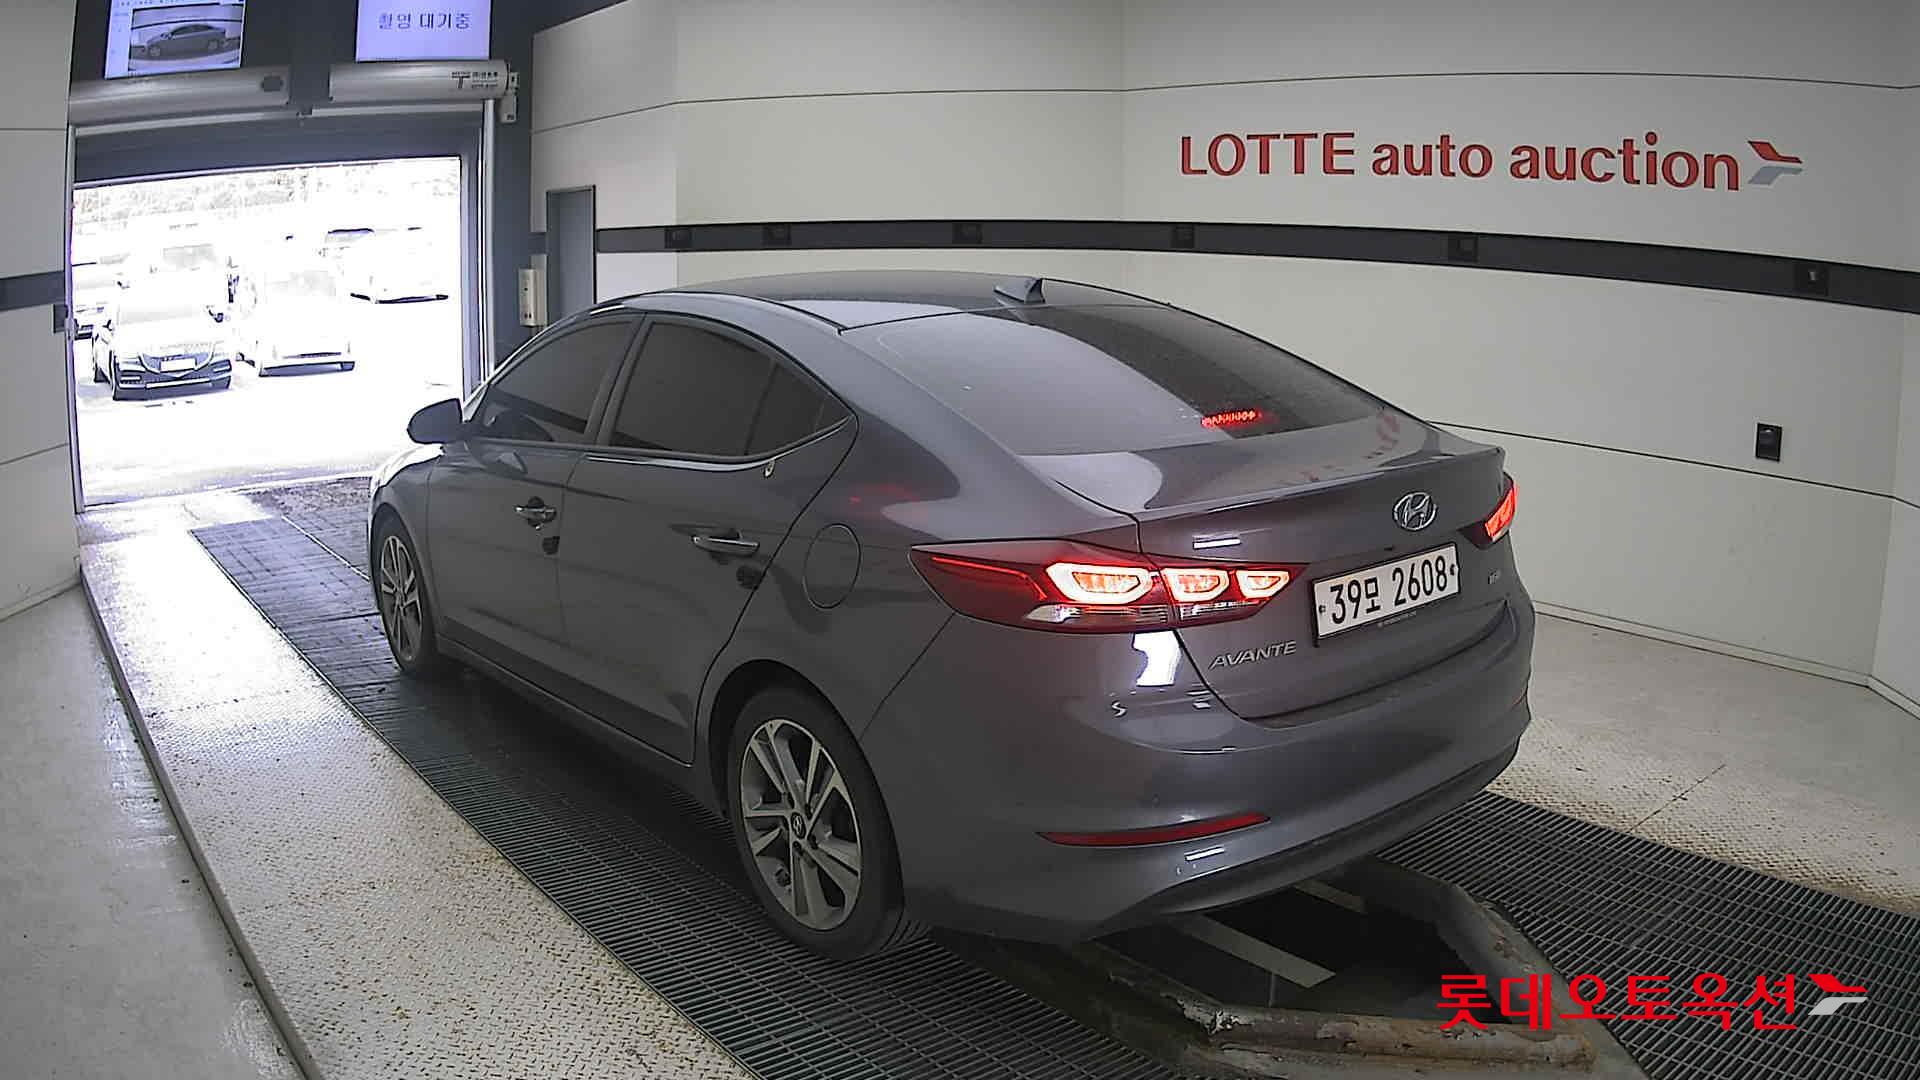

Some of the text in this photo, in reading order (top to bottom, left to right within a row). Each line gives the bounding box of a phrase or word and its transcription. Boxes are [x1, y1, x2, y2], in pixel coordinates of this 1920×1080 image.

[420, 13, 470, 29] 대기중
[1181, 131, 1739, 191] LOTTE auto auction
[1330, 555, 1448, 624] 39모 2608
[1209, 640, 1297, 670] AVANTE
